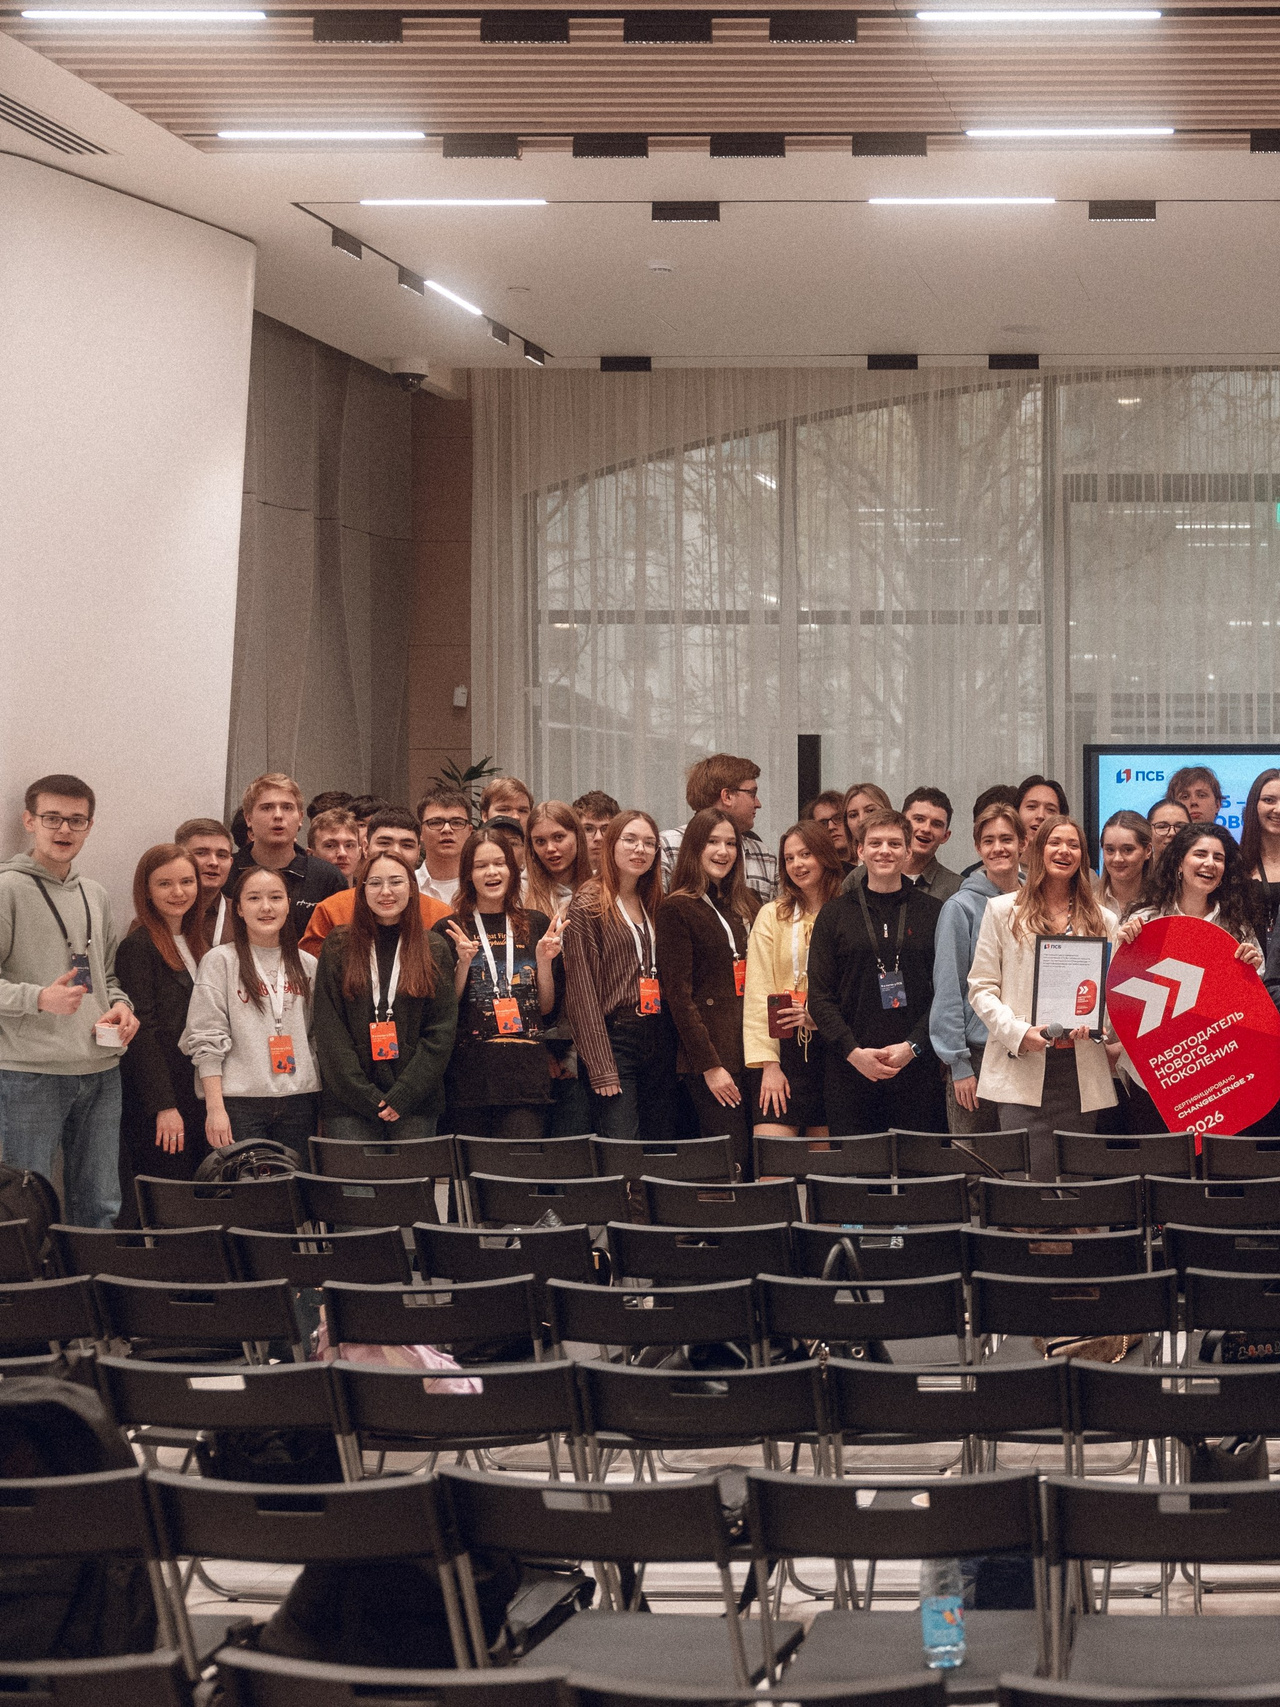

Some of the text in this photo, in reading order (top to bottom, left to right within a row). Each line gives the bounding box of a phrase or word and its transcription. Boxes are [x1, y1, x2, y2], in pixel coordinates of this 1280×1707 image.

[1135, 769, 1165, 782] ПСБ
[1148, 1011, 1245, 1068] РАБОТОДАТЕЛЬ
[1154, 1044, 1208, 1079] НОВОГО
[1160, 1040, 1239, 1090] ПОКОЛЕНИЯ
[1174, 1074, 1236, 1111] СЕРТИФИЦИРОВАНО
[1177, 1077, 1246, 1119] CHANGELLENGE
